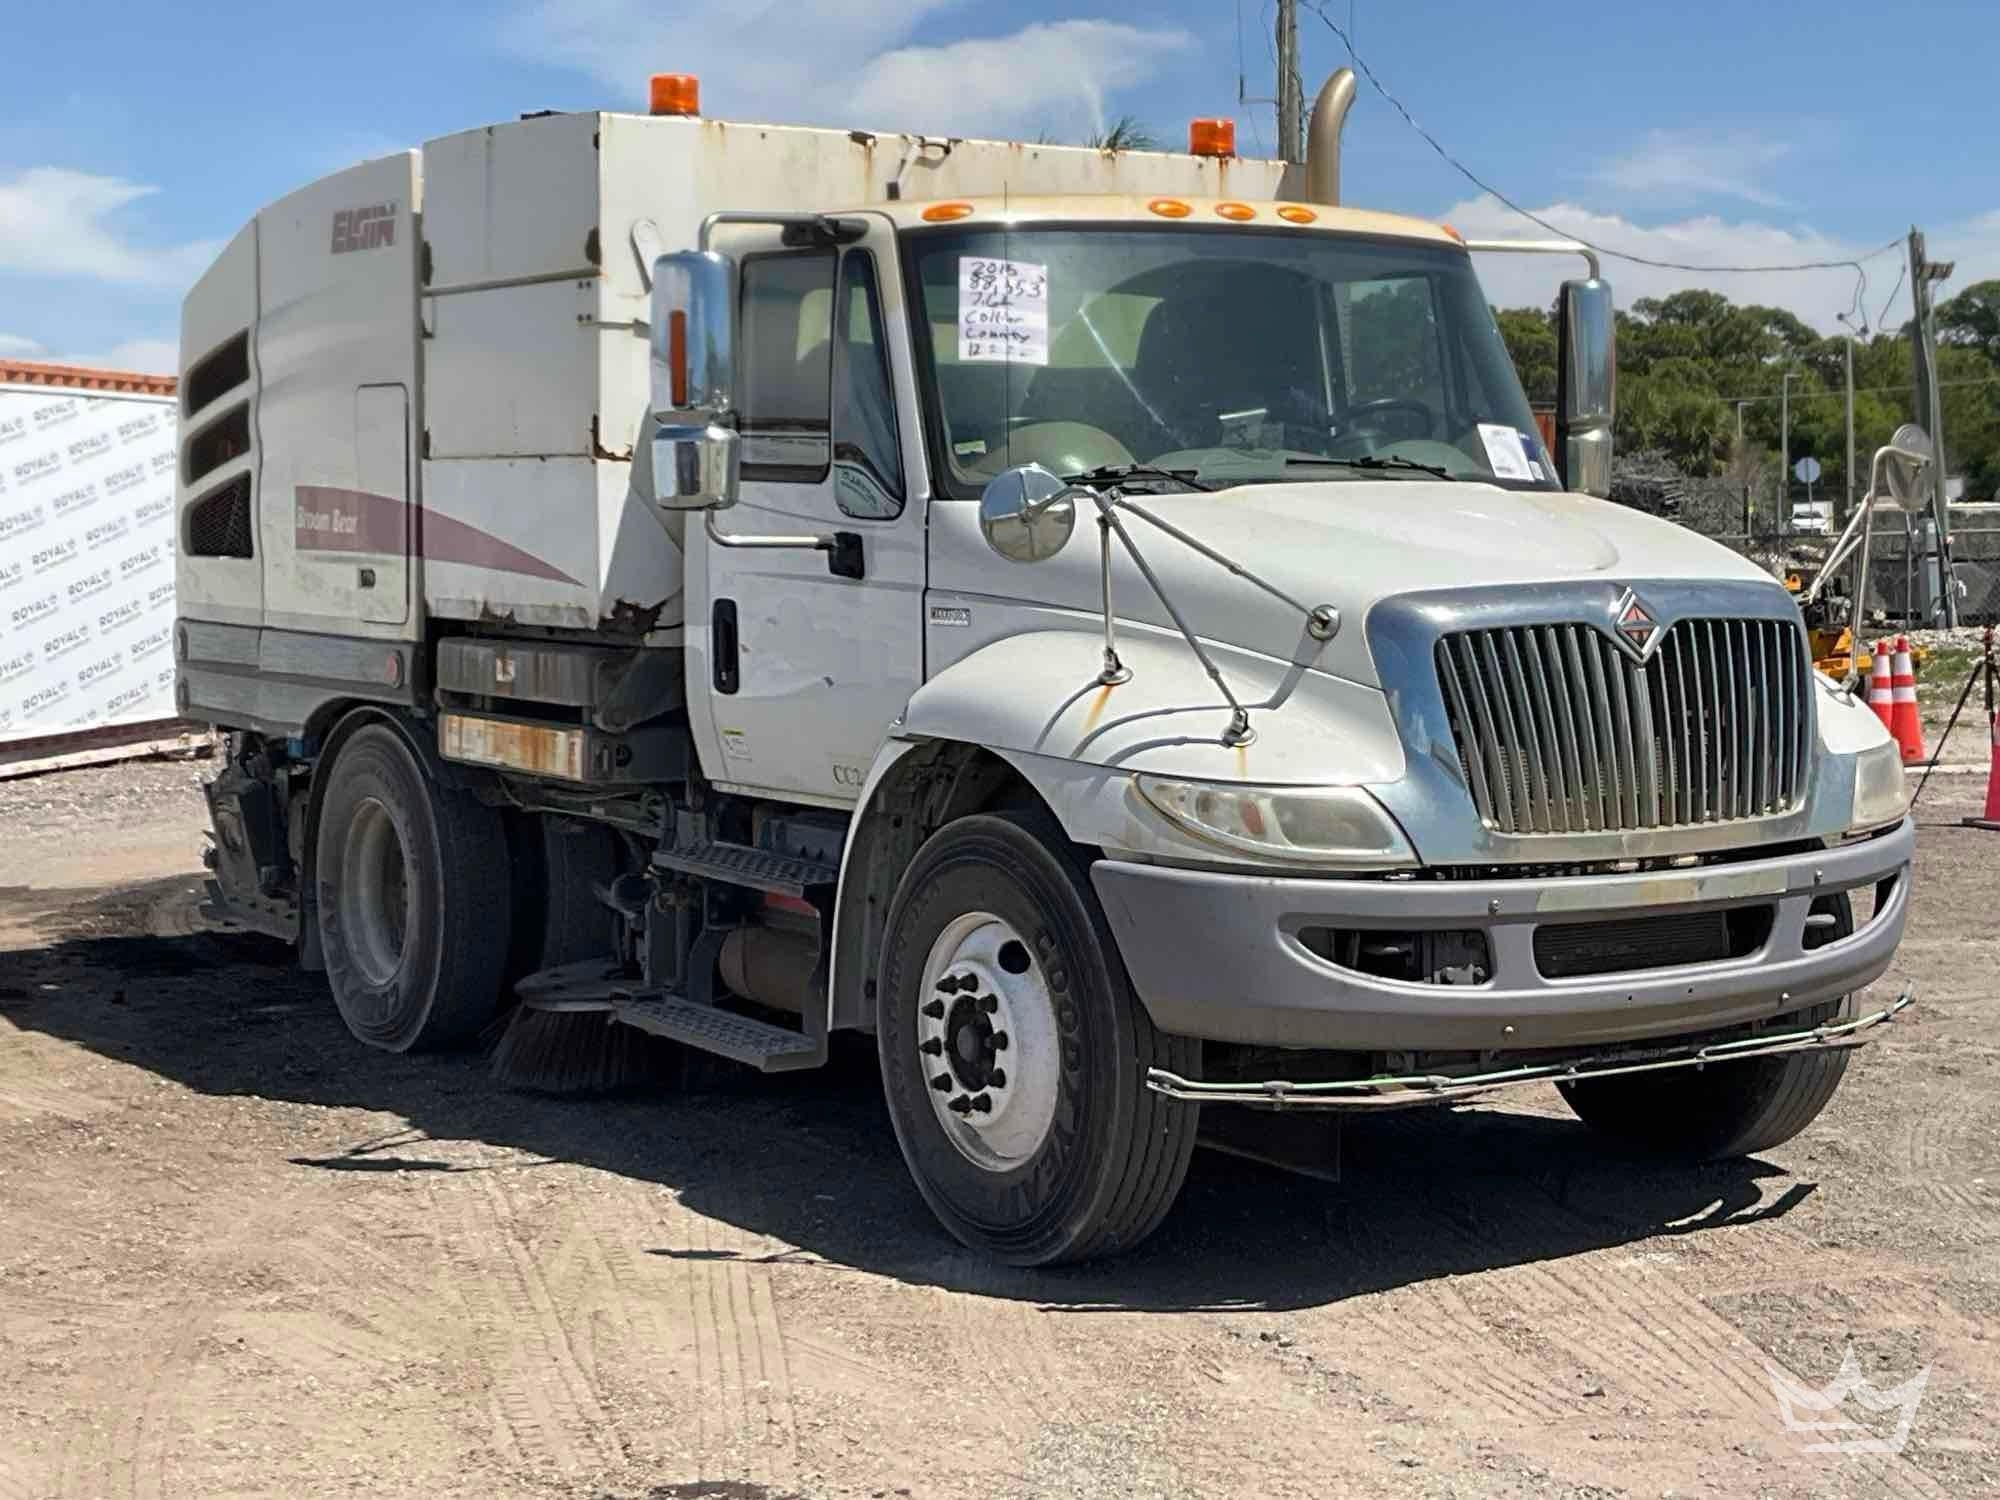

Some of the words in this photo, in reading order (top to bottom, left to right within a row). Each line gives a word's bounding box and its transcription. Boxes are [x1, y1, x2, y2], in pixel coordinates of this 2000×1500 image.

[331, 203, 397, 254] ELGIN
[33, 403, 67, 420] ROYAL
[118, 420, 149, 436] ROYAL
[68, 437, 101, 455] ROYAL
[15, 455, 50, 476] ROYAL
[104, 469, 136, 487] ROYAL
[54, 489, 87, 509] ROYAL
[135, 501, 166, 518] ROYAL
[86, 520, 118, 540] ROYAL
[32, 543, 67, 565] ROYAL
[120, 550, 152, 570] ROYAL
[68, 574, 102, 595] ROYAL
[12, 599, 48, 622] ROYAL
[98, 604, 131, 625] ROYAL
[44, 629, 80, 652] ROYAL
[131, 633, 163, 653] ROYAL
[78, 656, 112, 681] ROYAL
[23, 687, 58, 710] ROYAL
[107, 689, 141, 709] ROYAL
